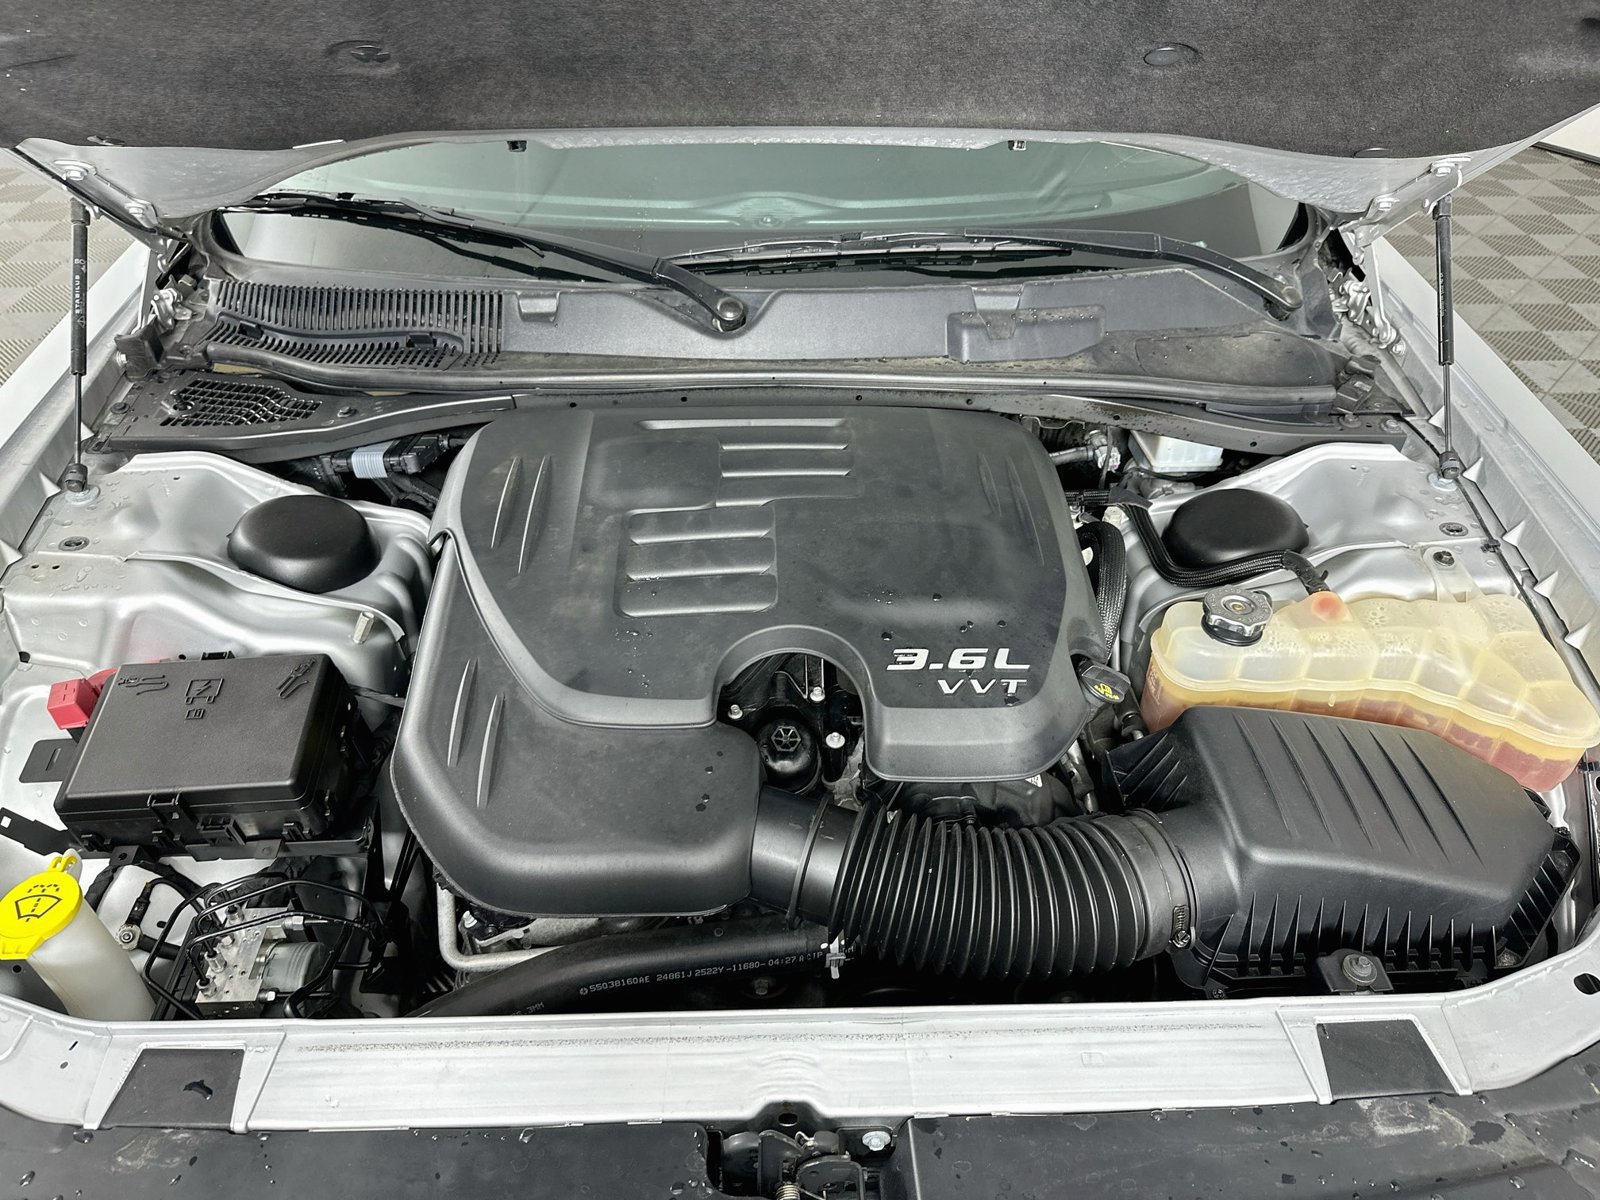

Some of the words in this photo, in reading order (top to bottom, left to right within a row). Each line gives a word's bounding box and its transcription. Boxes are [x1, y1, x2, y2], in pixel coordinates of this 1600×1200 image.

[886, 648, 1031, 671] 3.6L
[937, 679, 1028, 696] VVT
[589, 975, 650, 993] 55038160AE
